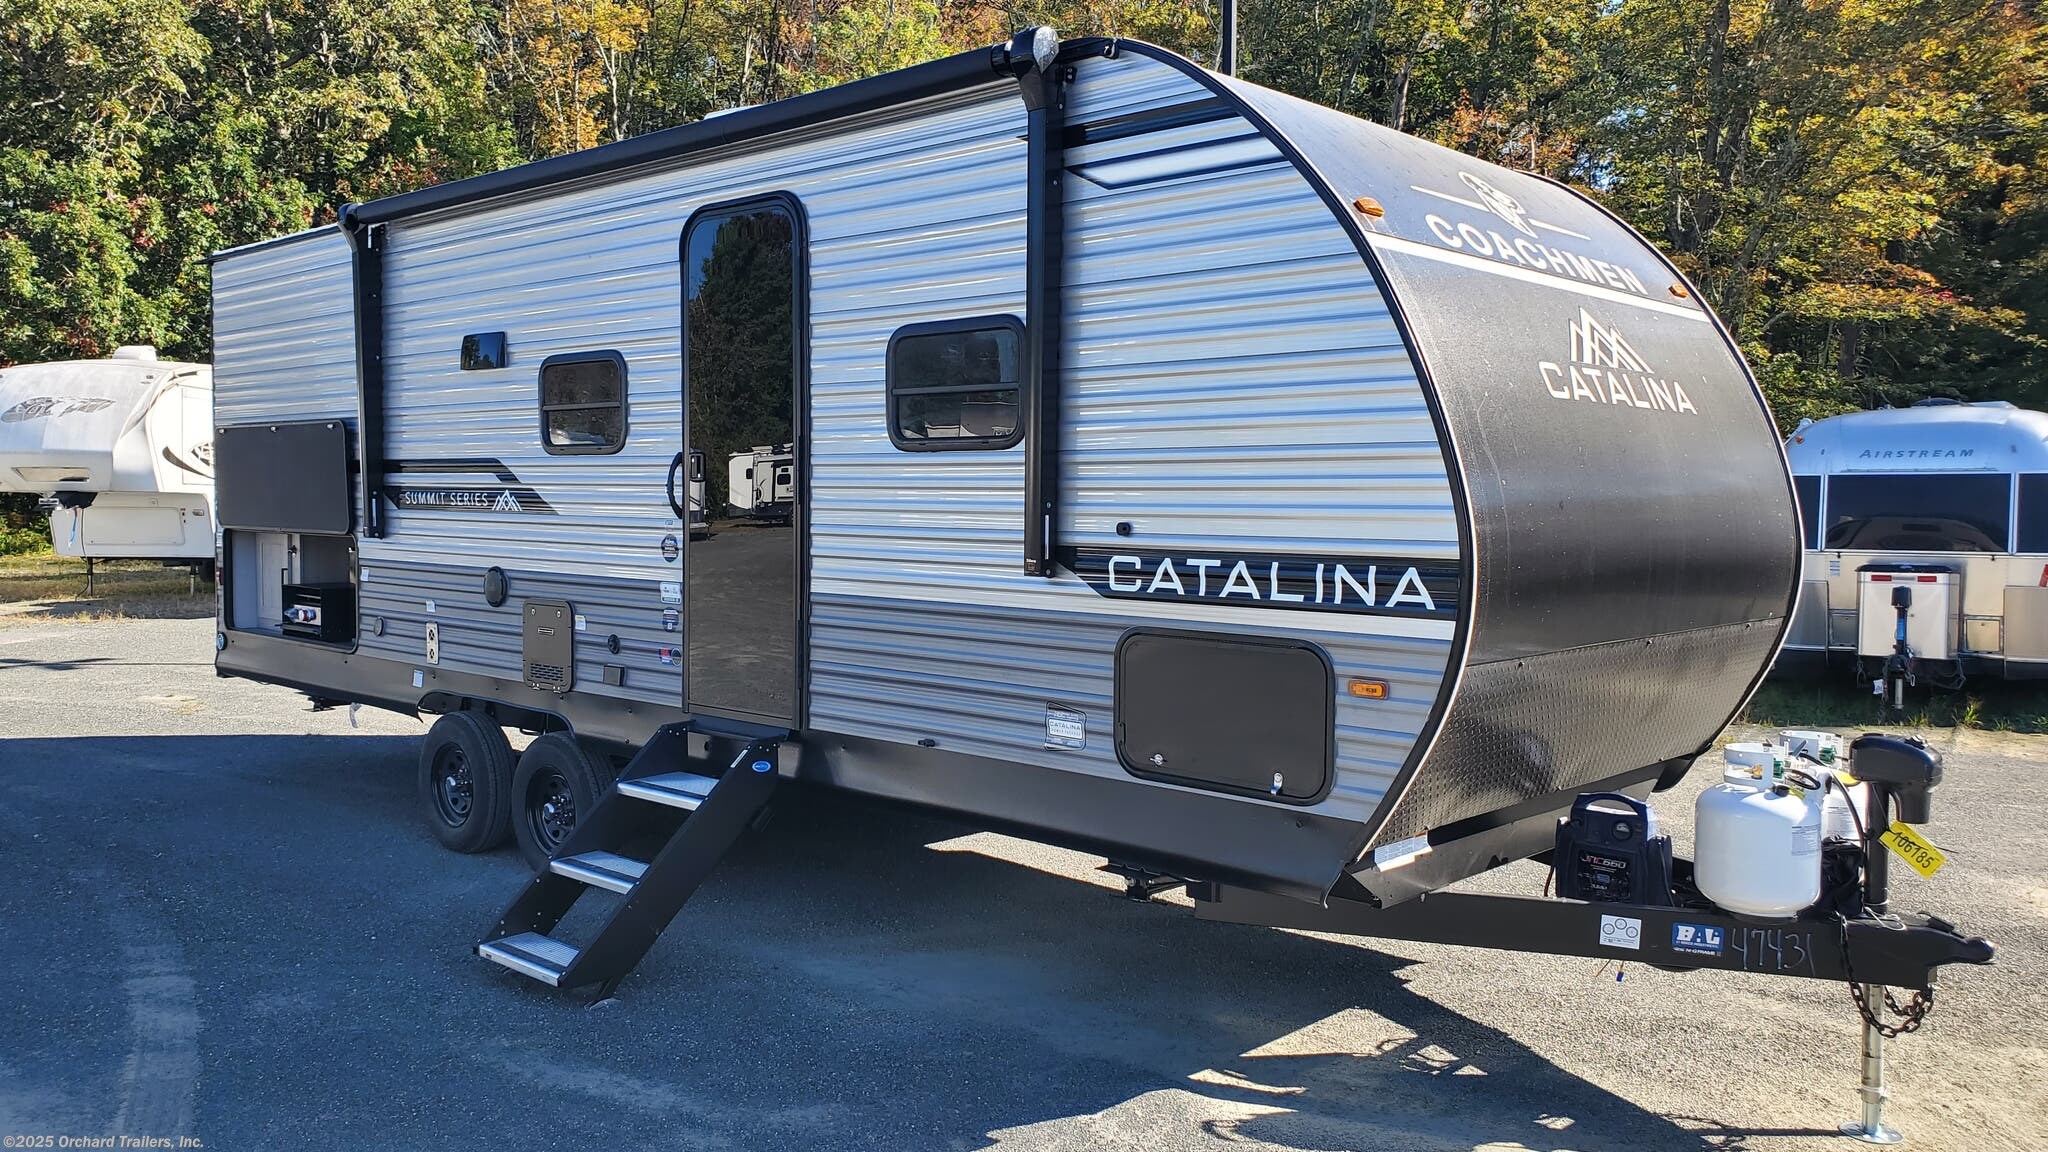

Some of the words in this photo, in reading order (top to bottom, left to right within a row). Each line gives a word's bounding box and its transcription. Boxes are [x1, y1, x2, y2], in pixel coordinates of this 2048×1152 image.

[1425, 214, 1648, 295] COACHMEN
[1538, 361, 1698, 415] CATALINA
[1858, 449, 1975, 459] AIRSTREAM
[404, 491, 446, 505] SUMMIT
[450, 492, 488, 507] SERIES
[1108, 555, 1436, 611] CATALINA
[1892, 831, 1935, 869] 106185
[1676, 925, 1721, 945] BAL
[1731, 927, 1816, 977] 47431
